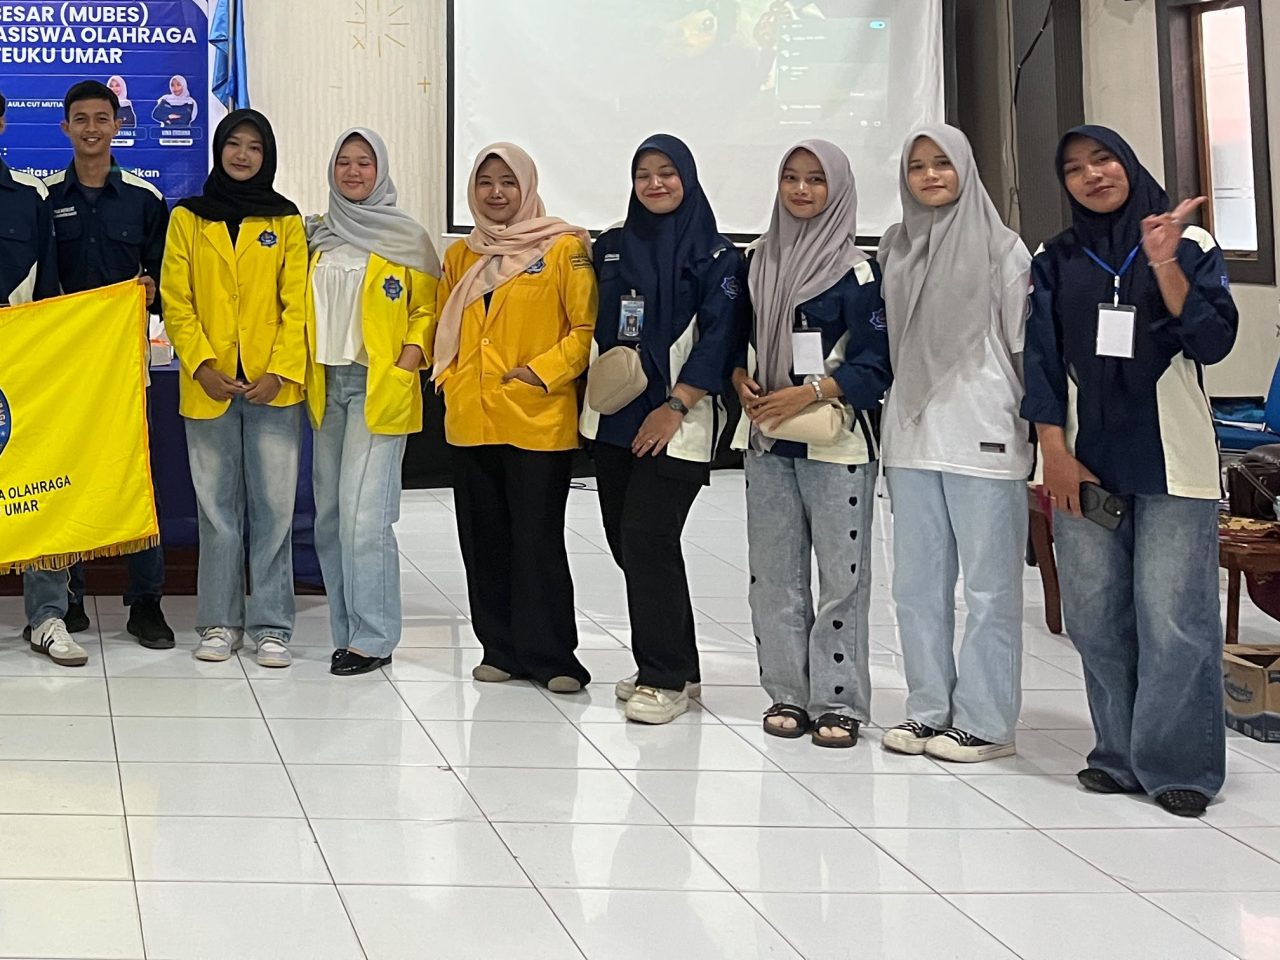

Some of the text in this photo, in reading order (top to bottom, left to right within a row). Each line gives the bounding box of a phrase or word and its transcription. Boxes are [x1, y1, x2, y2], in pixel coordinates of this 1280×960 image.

[60, 1, 149, 27] (MUBES)
[80, 26, 197, 44] OLAHRAGA
[60, 47, 123, 64] UMAR
[8, 474, 72, 500] OLAHRAGA
[4, 499, 39, 517] UMAR
